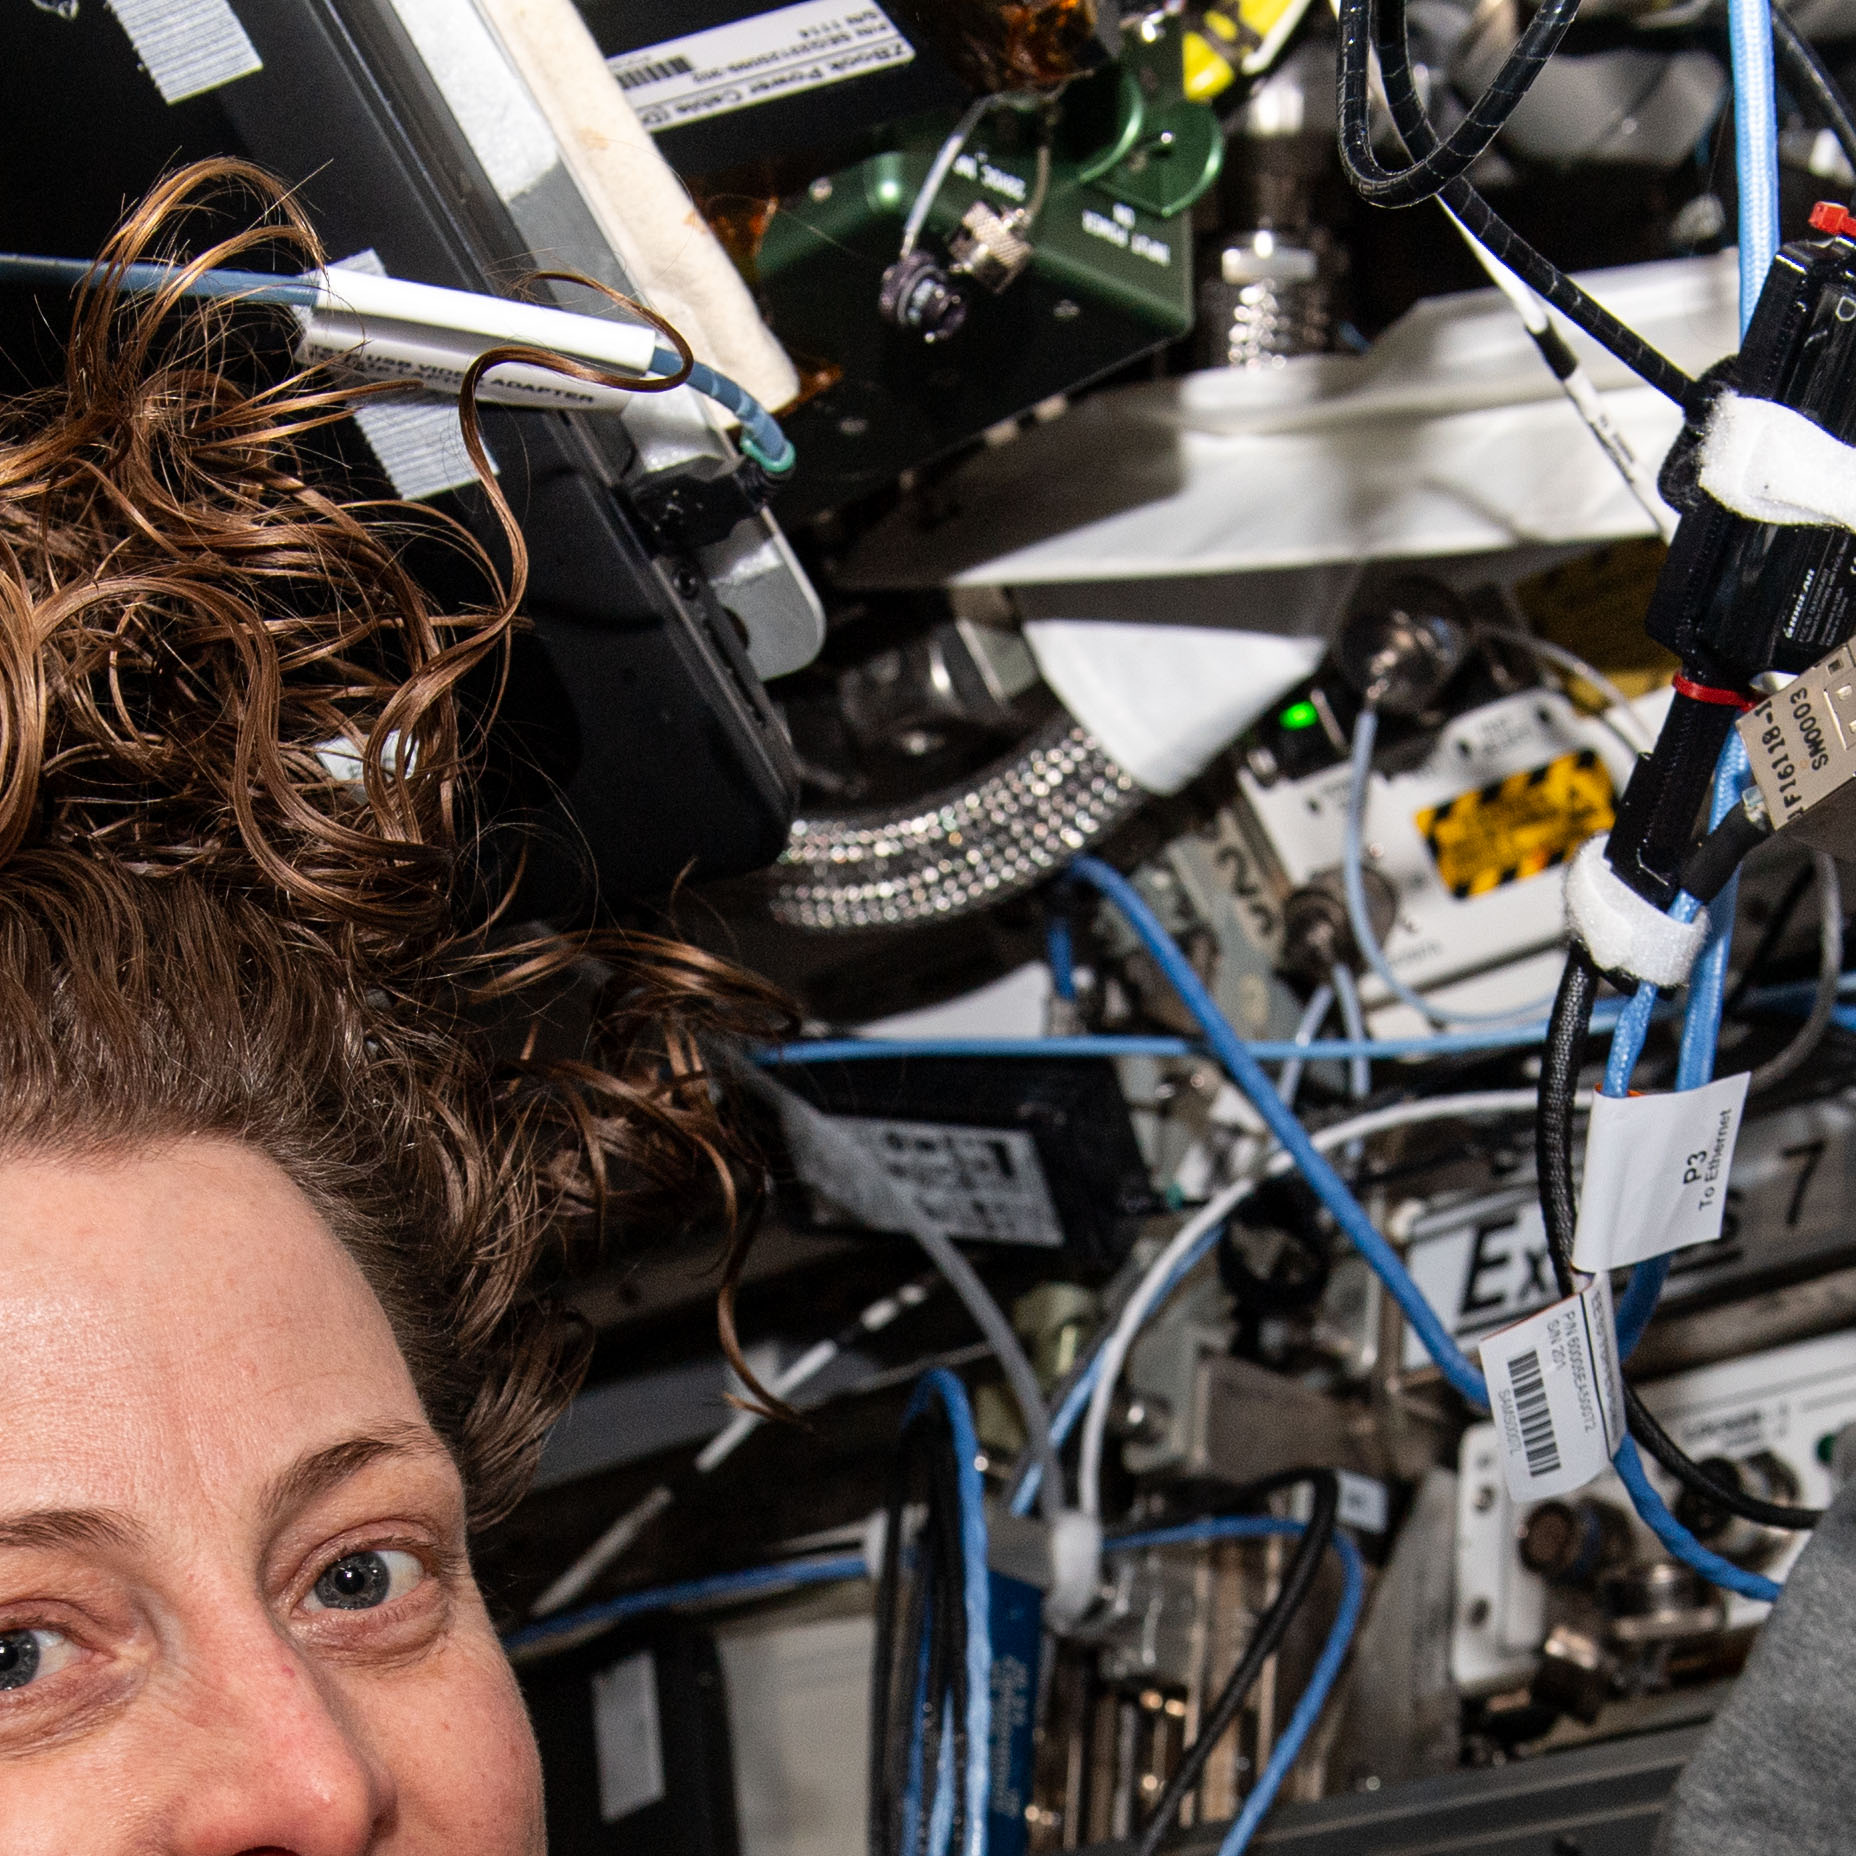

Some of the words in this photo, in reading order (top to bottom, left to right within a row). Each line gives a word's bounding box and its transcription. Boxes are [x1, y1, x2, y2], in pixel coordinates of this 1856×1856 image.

[749, 66, 825, 95] Power
[674, 88, 744, 115] Cable
[492, 377, 595, 404] ADAPTER
[1704, 1108, 1733, 1184] Ethernet
[1682, 1150, 1708, 1186] P3
[1699, 1186, 1717, 1212] To
